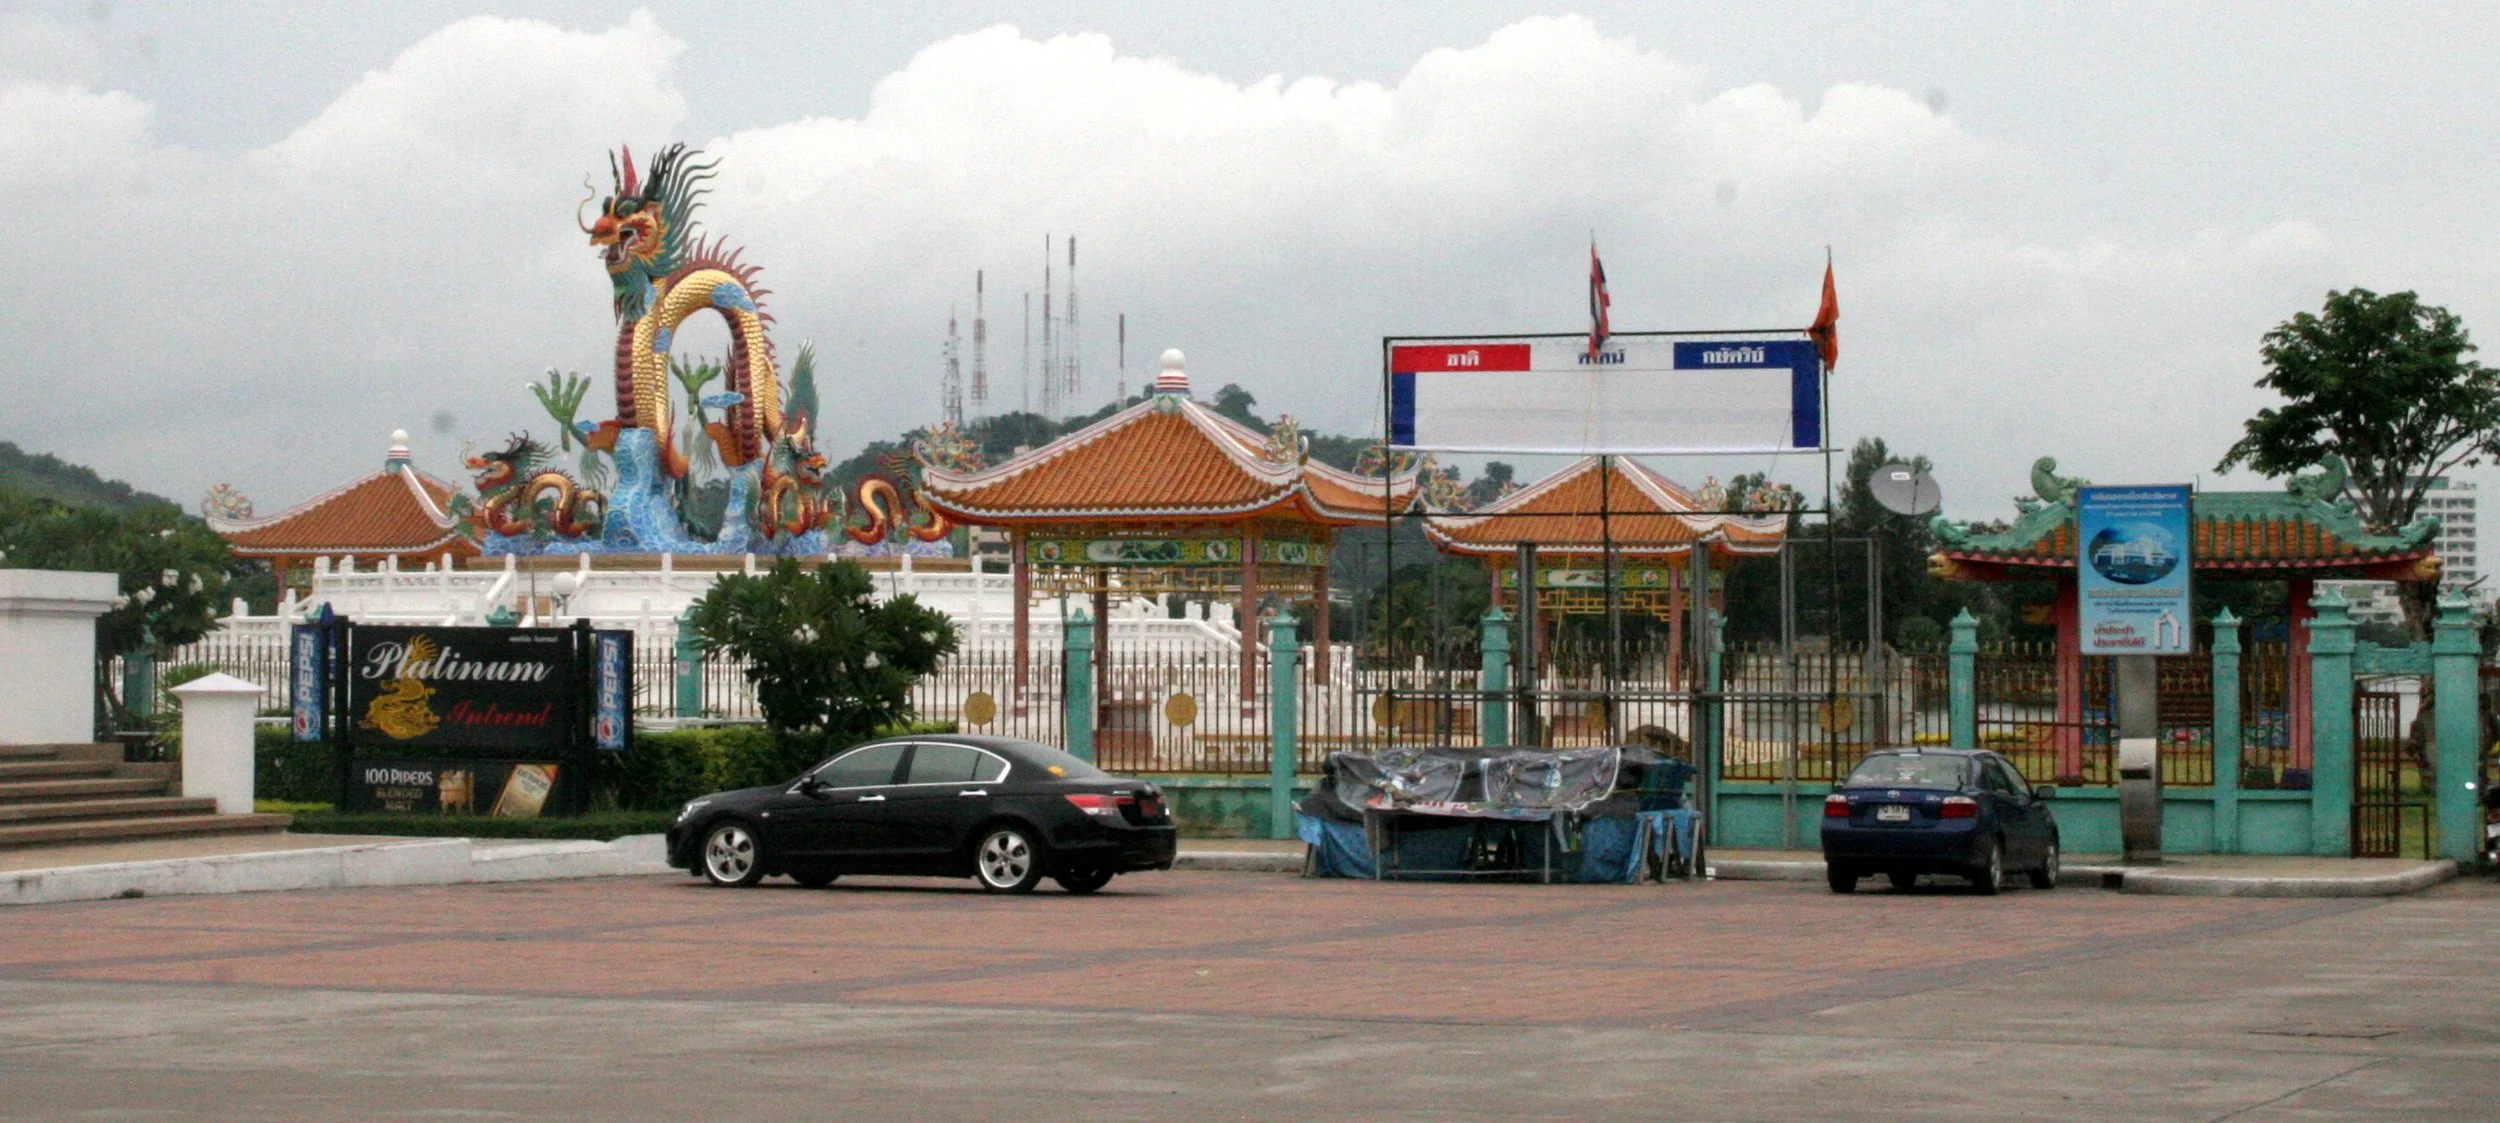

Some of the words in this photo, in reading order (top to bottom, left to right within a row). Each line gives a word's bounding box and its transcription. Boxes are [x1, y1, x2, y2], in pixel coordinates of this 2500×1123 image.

[1447, 349, 1480, 366] ชาติ
[1577, 348, 1626, 365] ศสน์
[299, 632, 314, 702] PEPSI
[361, 640, 554, 682] Platinum
[602, 638, 618, 709] PEPSI
[365, 768, 389, 785] 100
[391, 768, 434, 786] PIPERS
